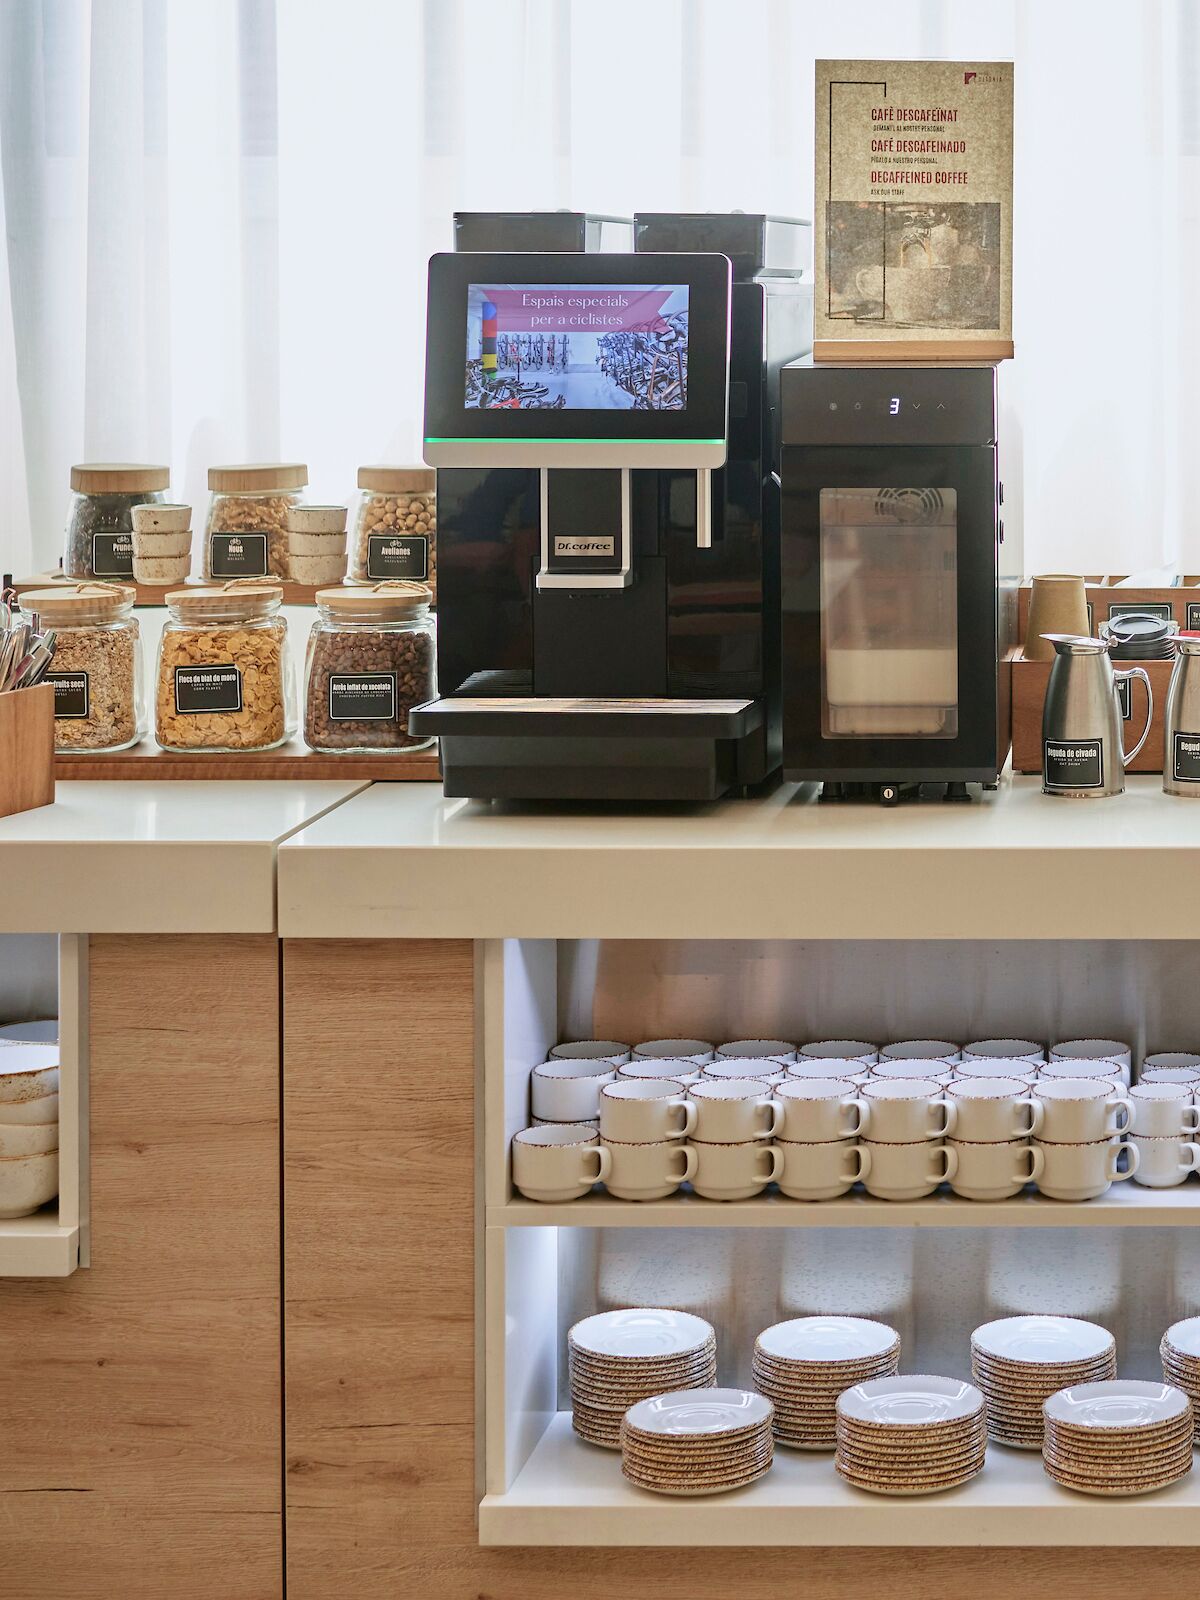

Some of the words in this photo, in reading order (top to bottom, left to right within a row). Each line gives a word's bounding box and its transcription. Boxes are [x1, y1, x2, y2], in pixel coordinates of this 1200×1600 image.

[896, 107, 958, 122] DESCAFEÏNAT
[896, 140, 966, 153] DESCAFEINADO
[871, 171, 932, 184] DECAFFEINED
[935, 172, 968, 184] COFFEE
[523, 294, 564, 308] Espais
[568, 295, 628, 309] especials
[532, 316, 554, 327] per
[558, 316, 565, 324] a
[569, 313, 623, 325] ciclistes
[890, 398, 900, 414] 3
[229, 545, 244, 553] Nous
[381, 546, 411, 555] Avellanes
[179, 675, 192, 683] Flocs
[201, 675, 212, 683] blat
[1067, 749, 1075, 757] de
[1075, 749, 1097, 757] civada
